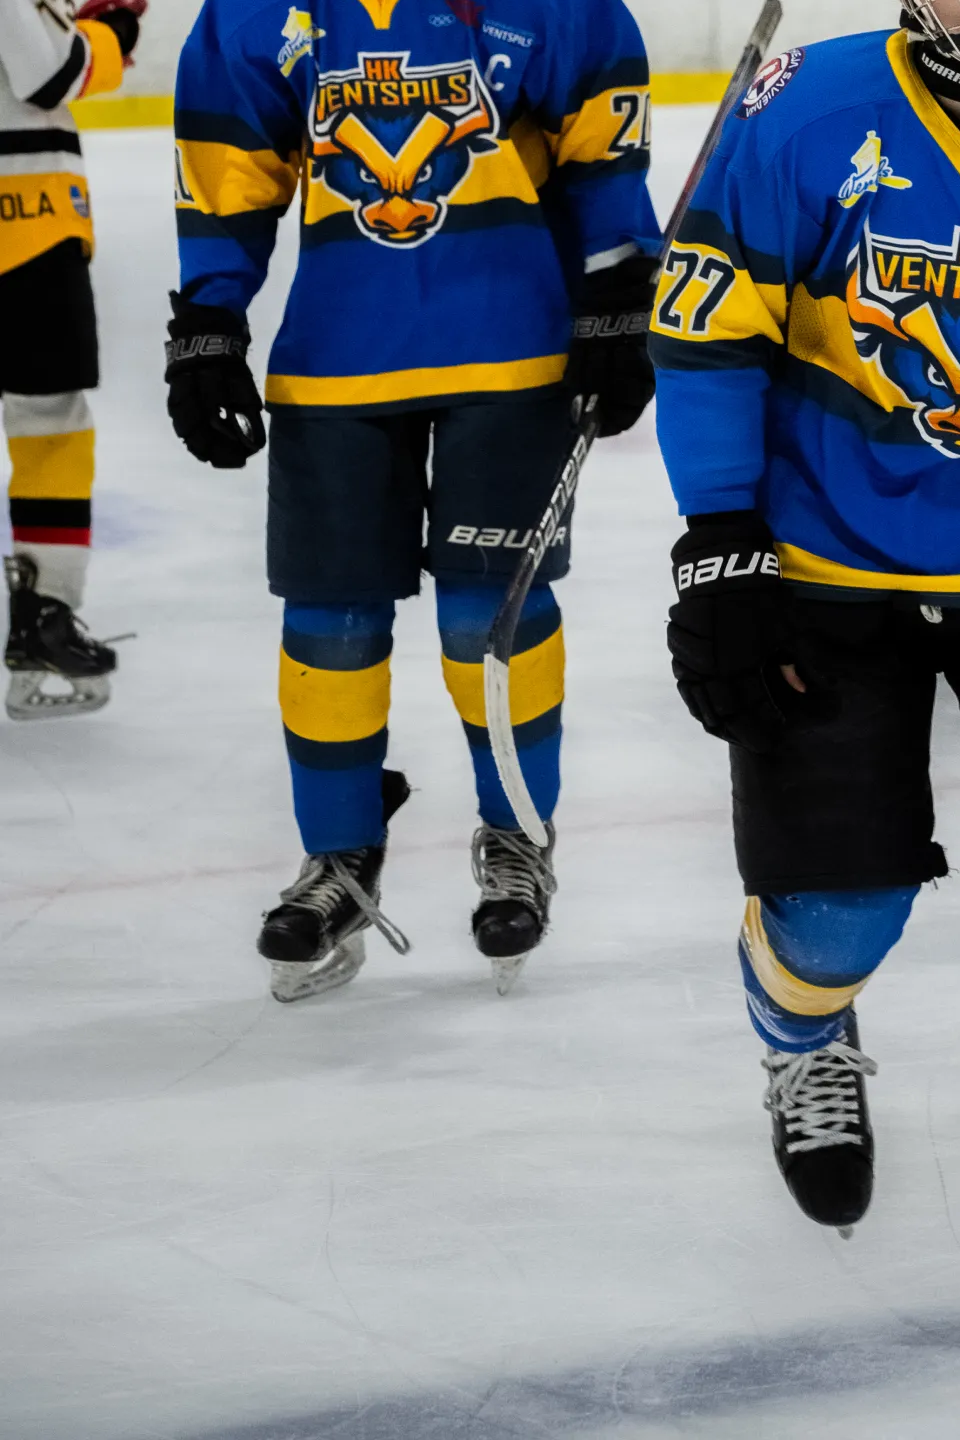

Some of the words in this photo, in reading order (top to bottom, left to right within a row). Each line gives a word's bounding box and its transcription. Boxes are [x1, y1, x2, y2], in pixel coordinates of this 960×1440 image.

[364, 59, 399, 81] HK
[483, 53, 512, 91] C
[655, 248, 737, 336] 27
[447, 524, 567, 549] BAUR
[678, 551, 783, 591] BAUE
